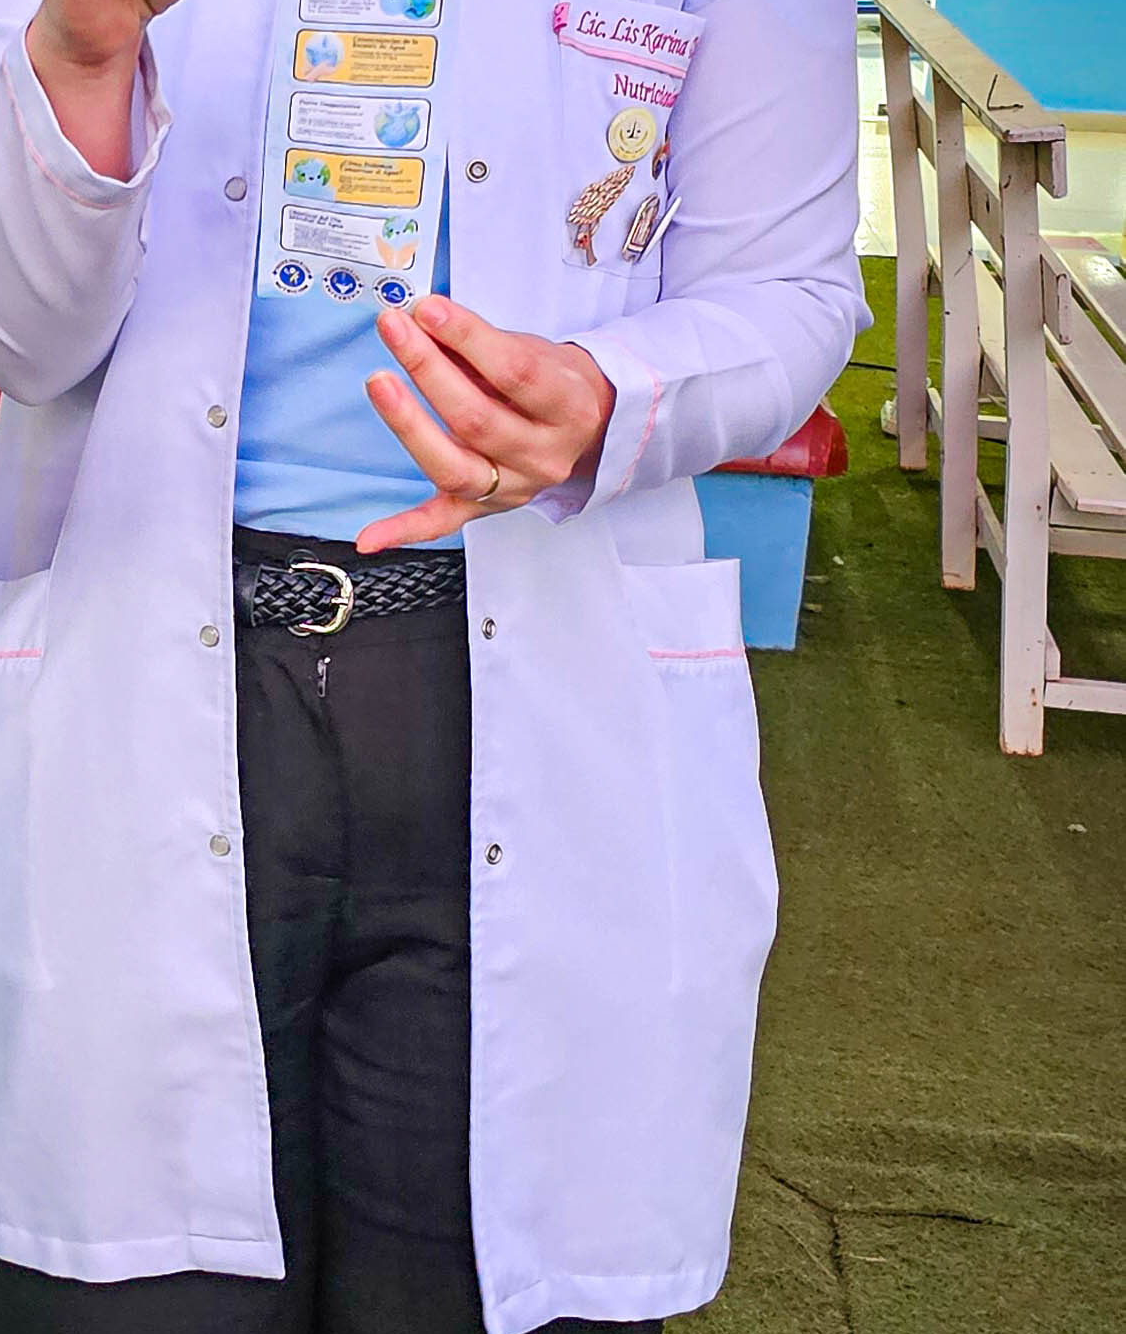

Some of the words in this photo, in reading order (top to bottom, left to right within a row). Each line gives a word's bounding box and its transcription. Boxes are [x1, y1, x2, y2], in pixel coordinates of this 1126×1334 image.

[576, 10, 606, 38] Lic.
[610, 17, 640, 44] Lis
[640, 23, 690, 55] Karina
